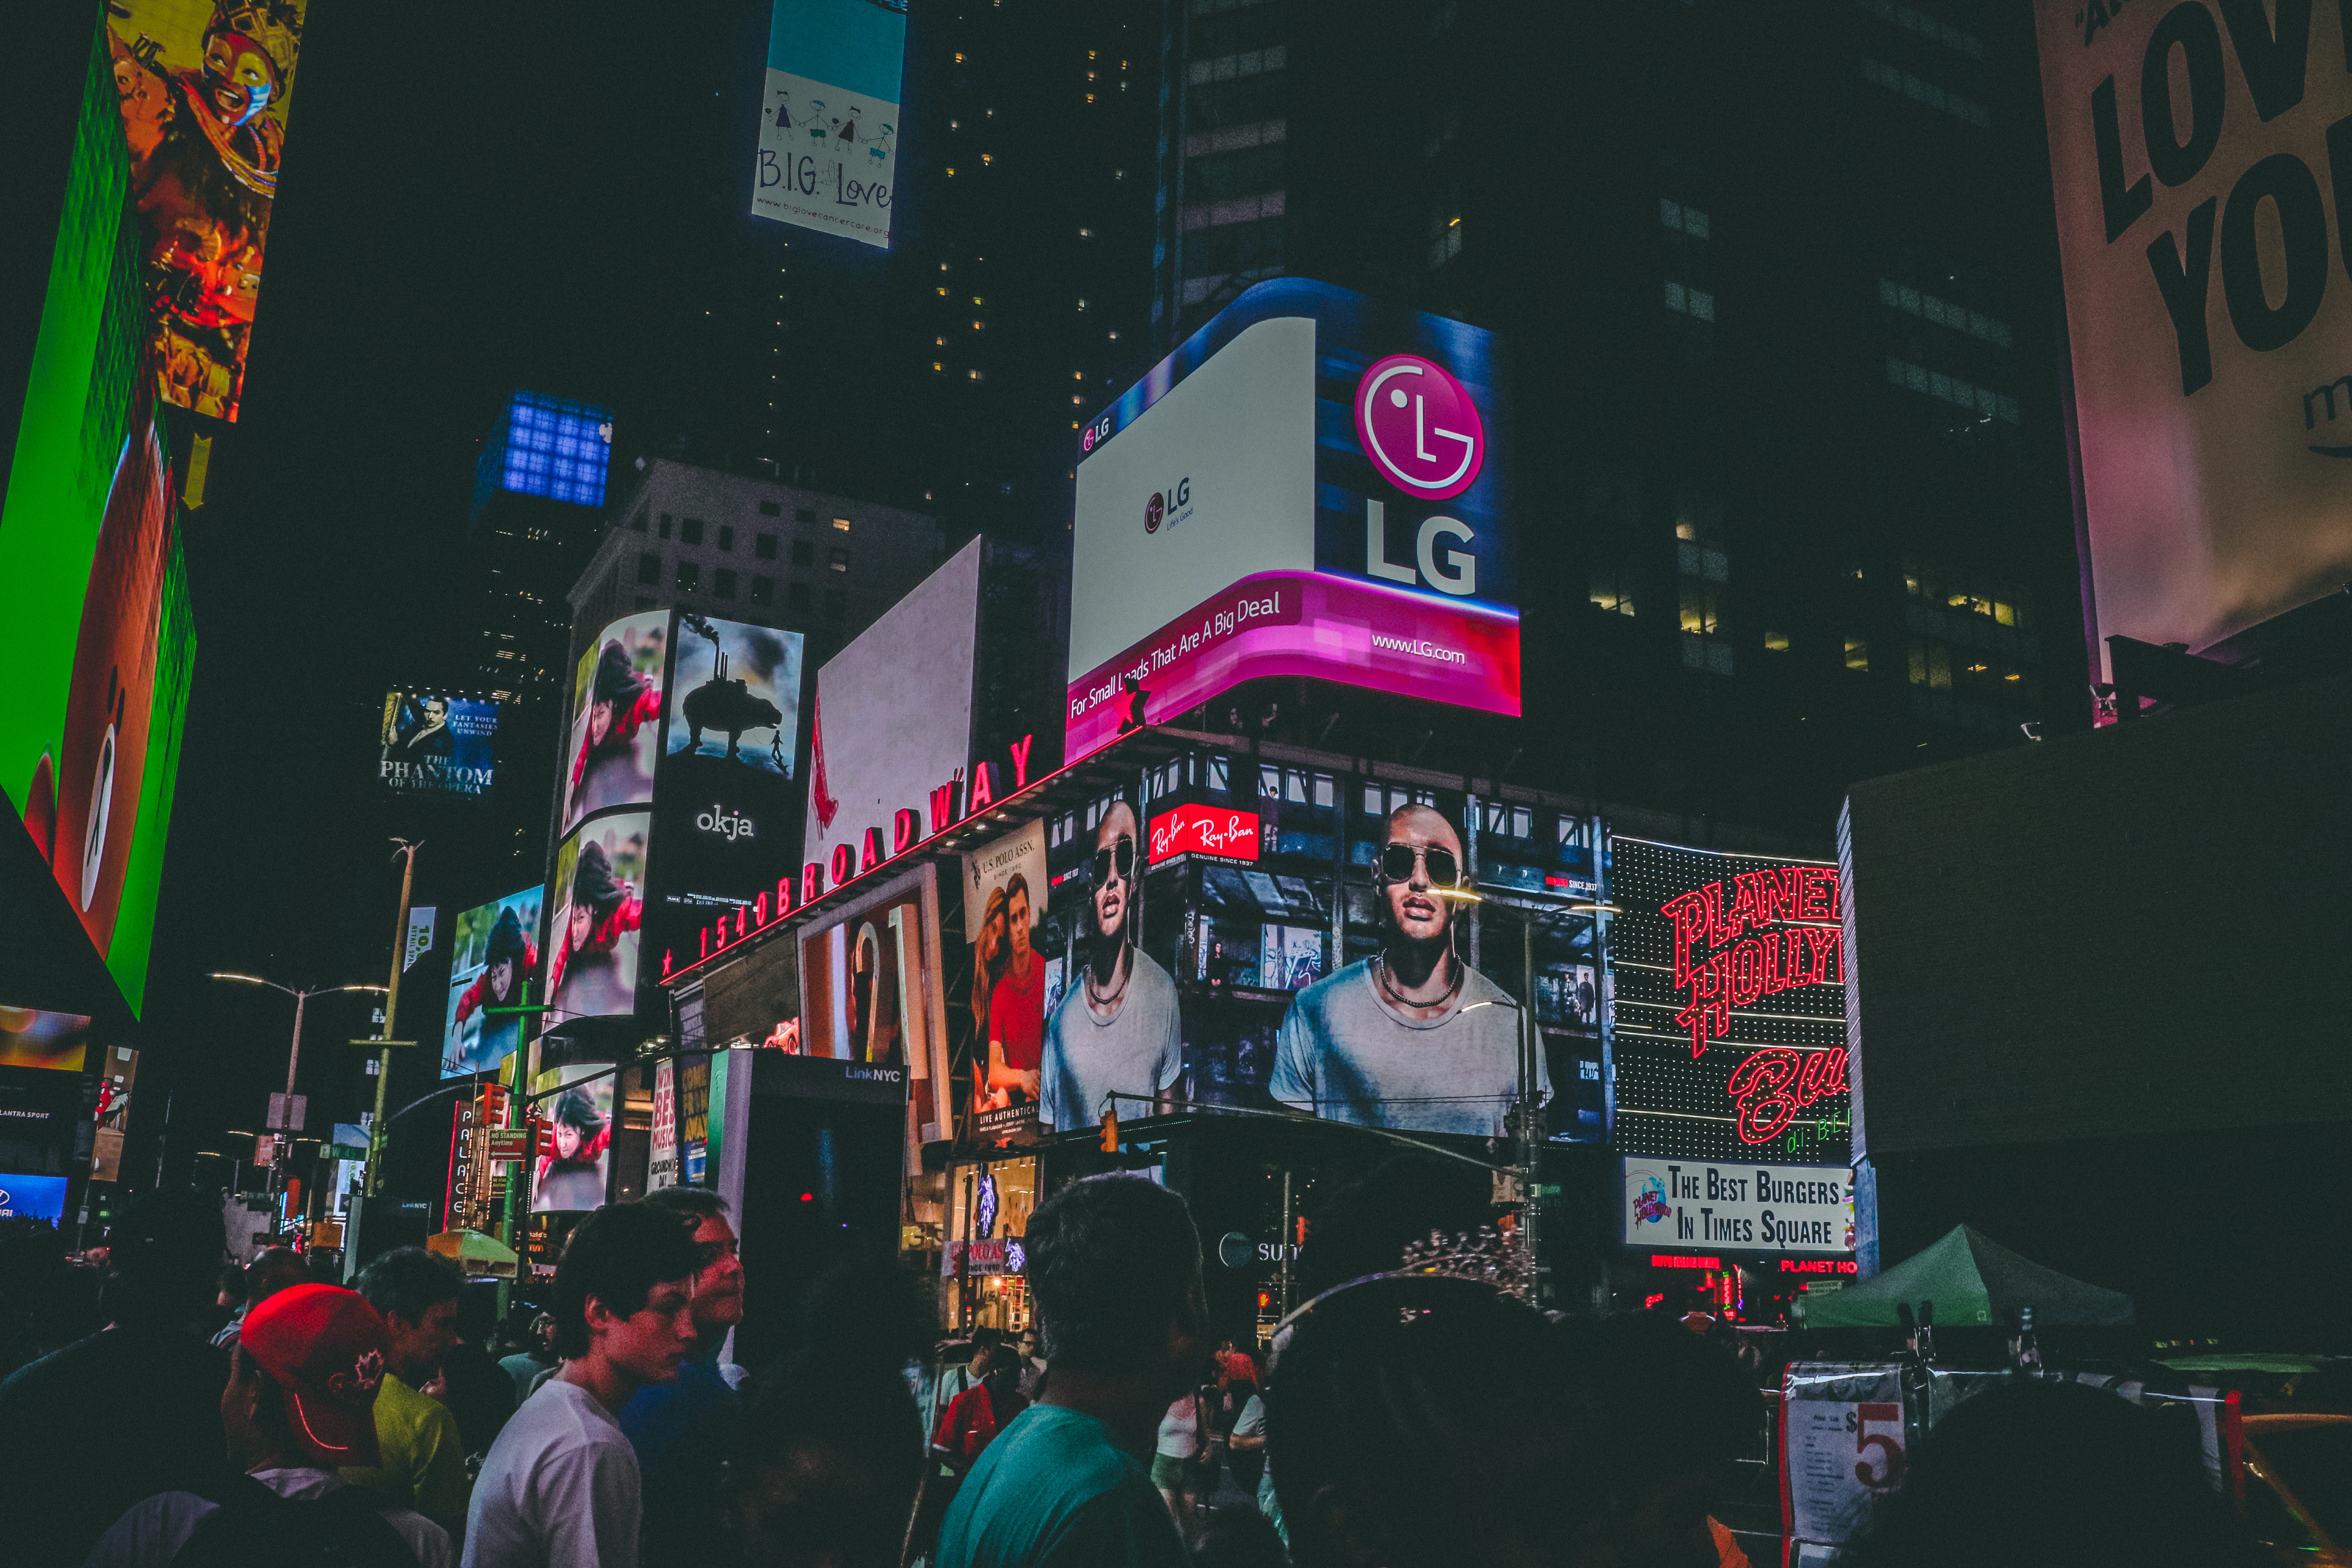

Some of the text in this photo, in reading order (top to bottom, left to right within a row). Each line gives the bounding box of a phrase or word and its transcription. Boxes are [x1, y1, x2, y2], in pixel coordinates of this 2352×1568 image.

[836, 163, 892, 207] Love
[1095, 417, 1109, 443] LG
[1167, 477, 1189, 516] LG
[1167, 505, 1193, 531] Life's Good
[1367, 498, 1476, 595] LG
[1071, 697, 1088, 719] For
[1089, 675, 1116, 709] Small
[1151, 643, 1177, 672] That
[1179, 632, 1200, 657] Are
[1202, 620, 1212, 644] A
[1215, 610, 1234, 636] Big
[1238, 591, 1280, 623] Deal
[1372, 634, 1465, 664] www.LG.com
[452, 721, 497, 730] FANTASIES
[457, 728, 492, 737] UNWIND
[380, 761, 494, 786] PHANTOM
[697, 805, 753, 840] okja
[983, 839, 1035, 873] U.S. POLO ASSN.
[994, 869, 1007, 880] SINCE
[1569, 880, 1584, 890] SINCE
[1585, 882, 1597, 891] 1937
[846, 1066, 900, 1082] LinkNYC
[980, 1114, 992, 1124] LIVE
[454, 1111, 472, 1213] PALACE
[1668, 1166, 1839, 1205] THE BEST BURGERS
[1633, 1191, 1659, 1218] PLANET
[1677, 1207, 1831, 1249] IN TIMES SQUARE
[1781, 1260, 1834, 1272] PLANET
